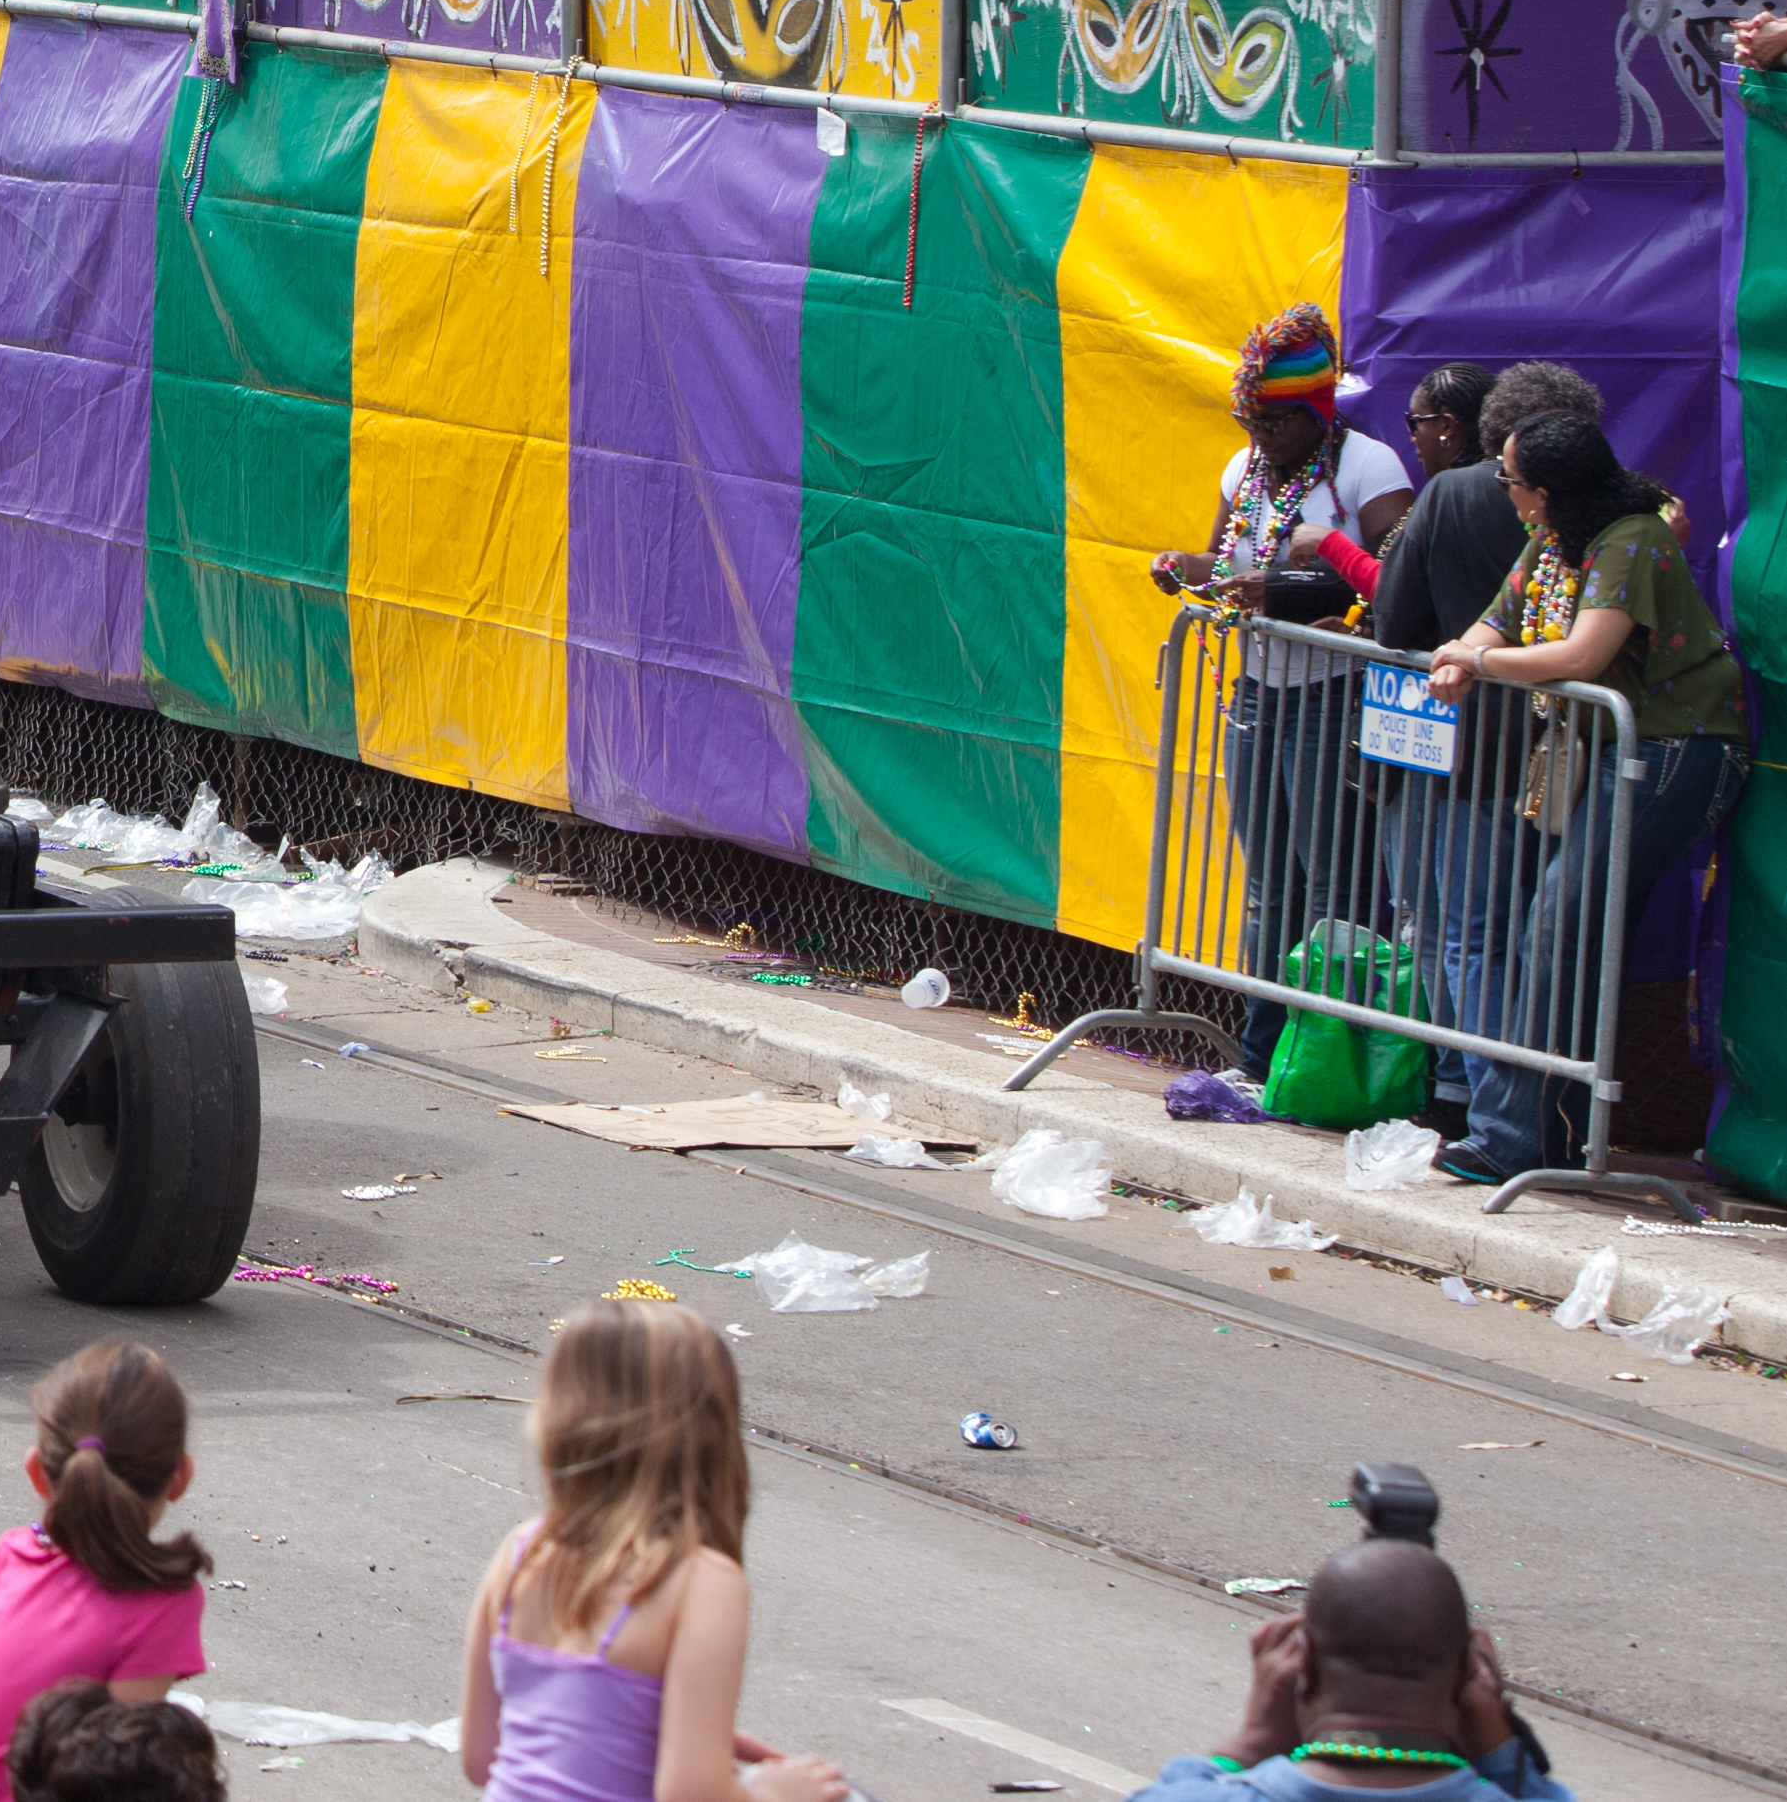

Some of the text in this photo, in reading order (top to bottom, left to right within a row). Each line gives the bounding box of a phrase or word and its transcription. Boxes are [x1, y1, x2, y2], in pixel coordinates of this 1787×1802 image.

[1379, 713, 1435, 741] POLICE LINE
[1368, 731, 1444, 764] DO NOT CROSS
